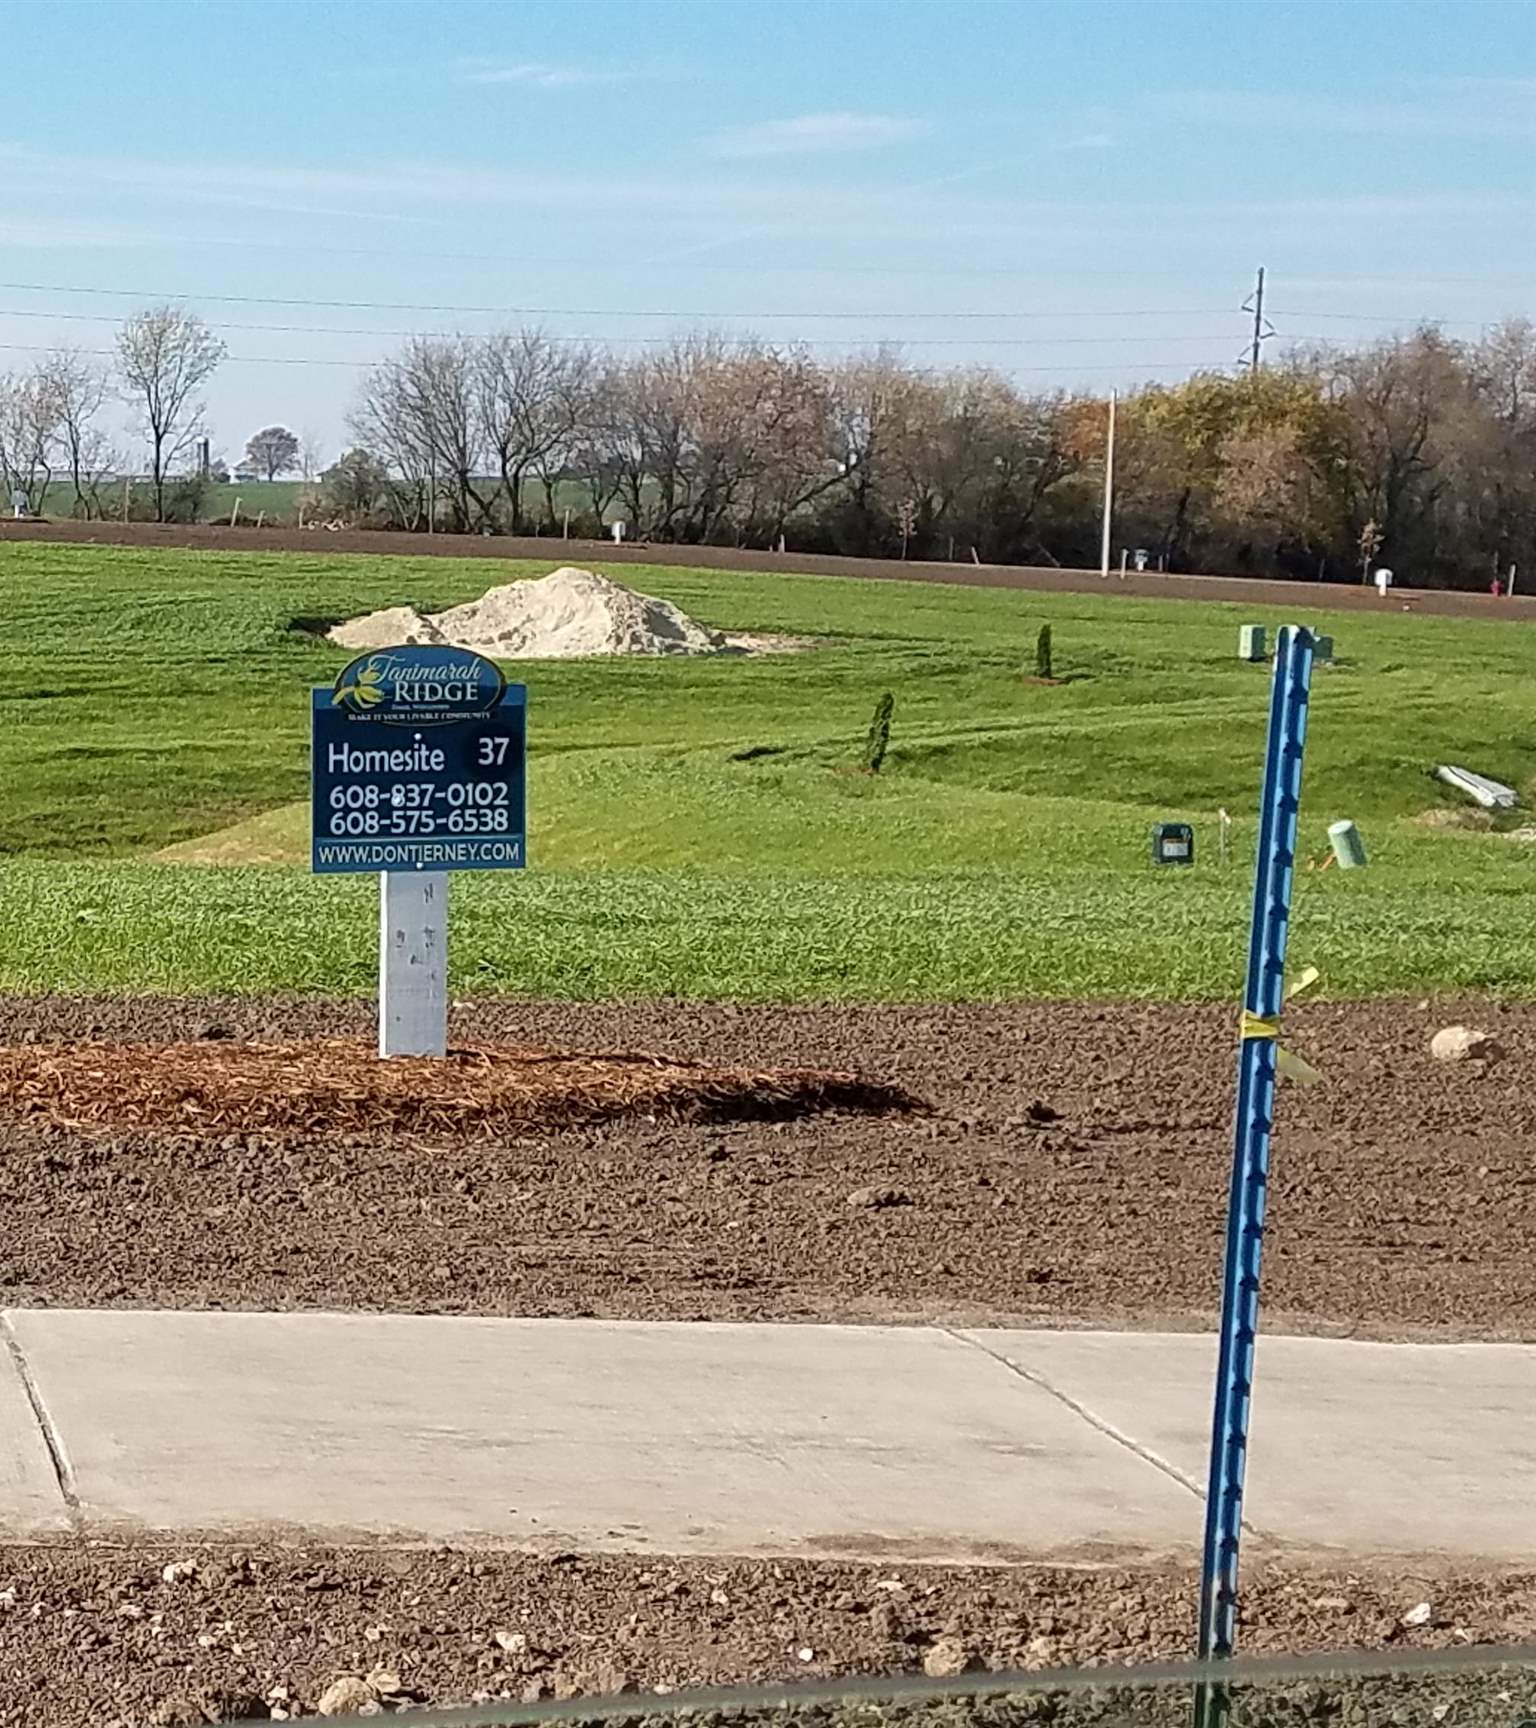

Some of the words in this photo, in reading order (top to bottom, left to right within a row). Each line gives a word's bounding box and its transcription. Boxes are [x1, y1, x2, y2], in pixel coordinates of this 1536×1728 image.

[360, 654, 482, 684] Tanimarah
[394, 681, 479, 702] RIDGE
[328, 742, 445, 773] Homesite
[478, 737, 510, 766] 37
[329, 782, 509, 809] 608-837-0102
[329, 808, 509, 835] 608-575-6538
[318, 842, 519, 864] WWW.DONTIERNEY.COM
